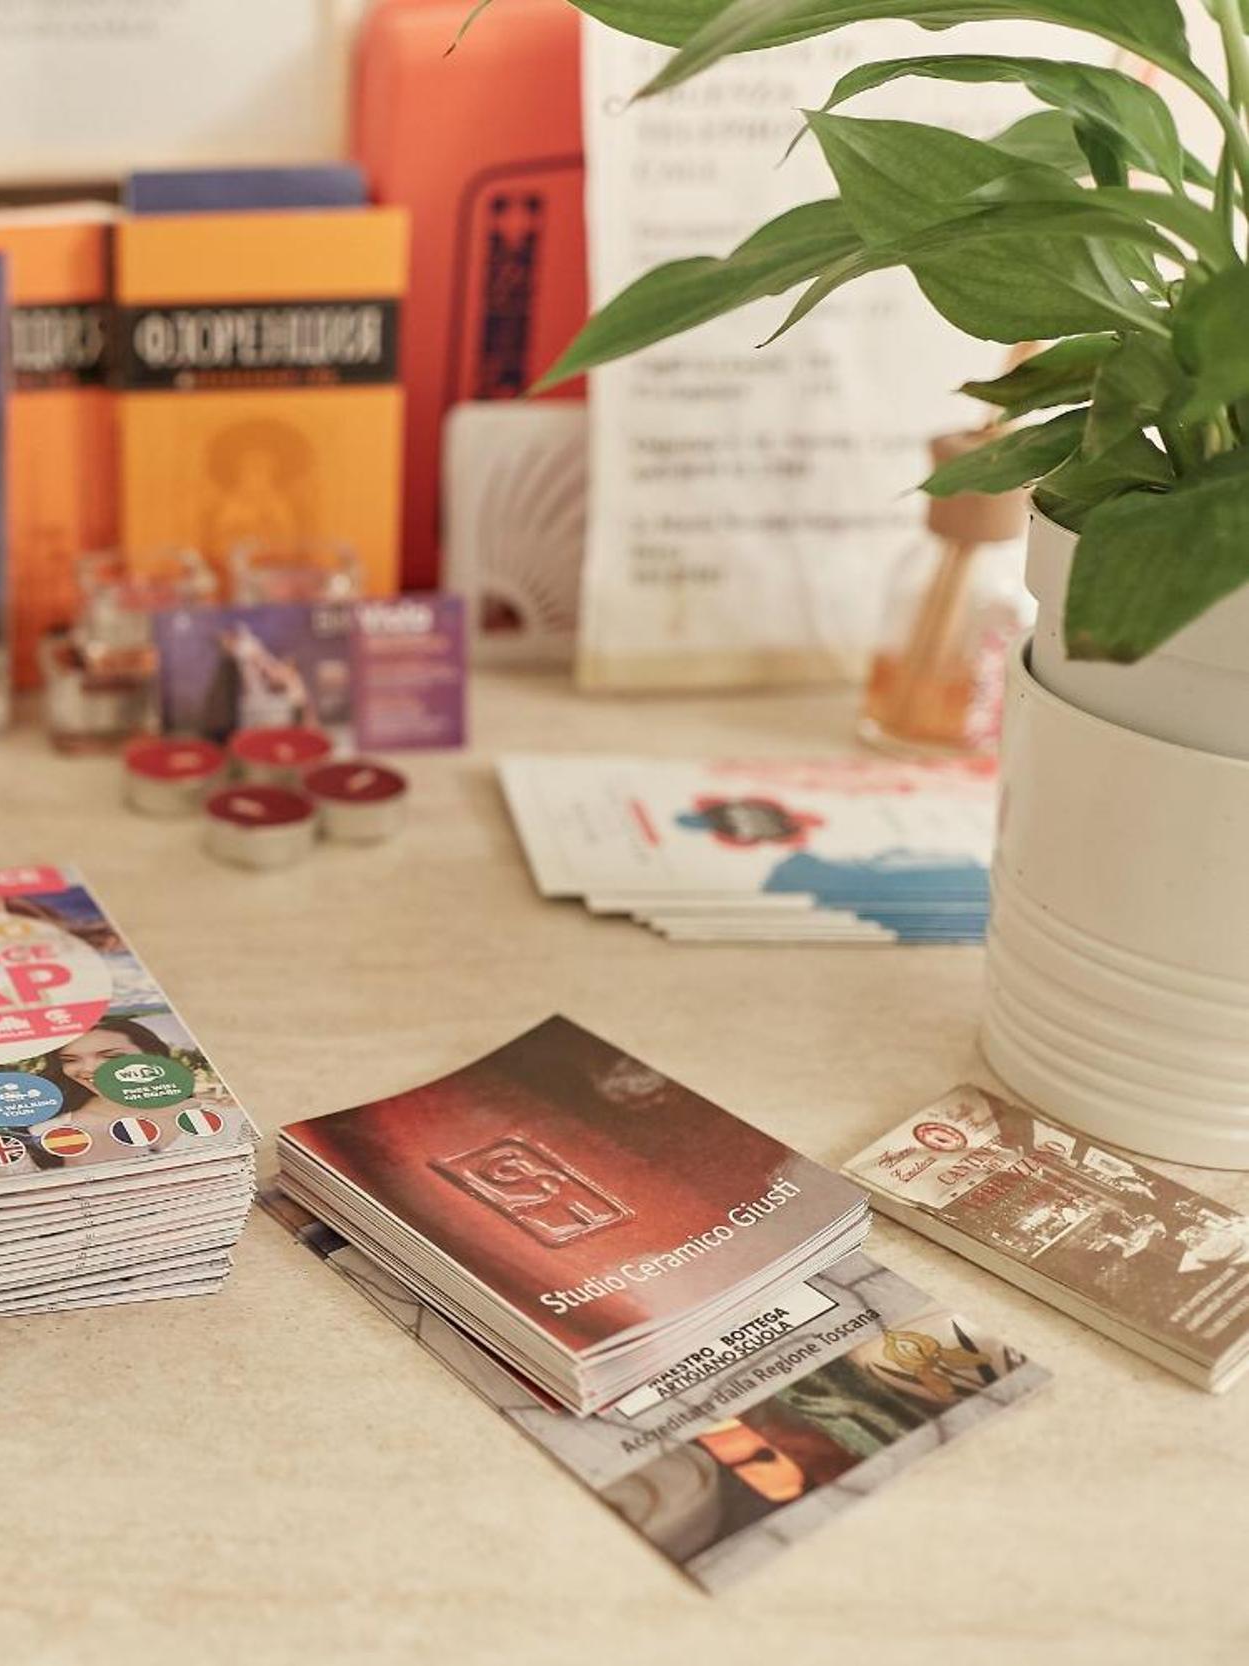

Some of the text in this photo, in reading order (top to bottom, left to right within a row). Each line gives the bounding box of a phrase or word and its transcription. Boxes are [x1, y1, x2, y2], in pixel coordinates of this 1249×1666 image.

[133, 306, 383, 369] ФЛОРЕНЦИЯ
[539, 1176, 802, 1315] Studio Ceramico Giusti
[655, 1320, 795, 1400] ARTIGIANO SCUOLA
[719, 1306, 791, 1347] BOTTEGA
[620, 1306, 882, 1455] Accreditata dalla Regione Toscana
